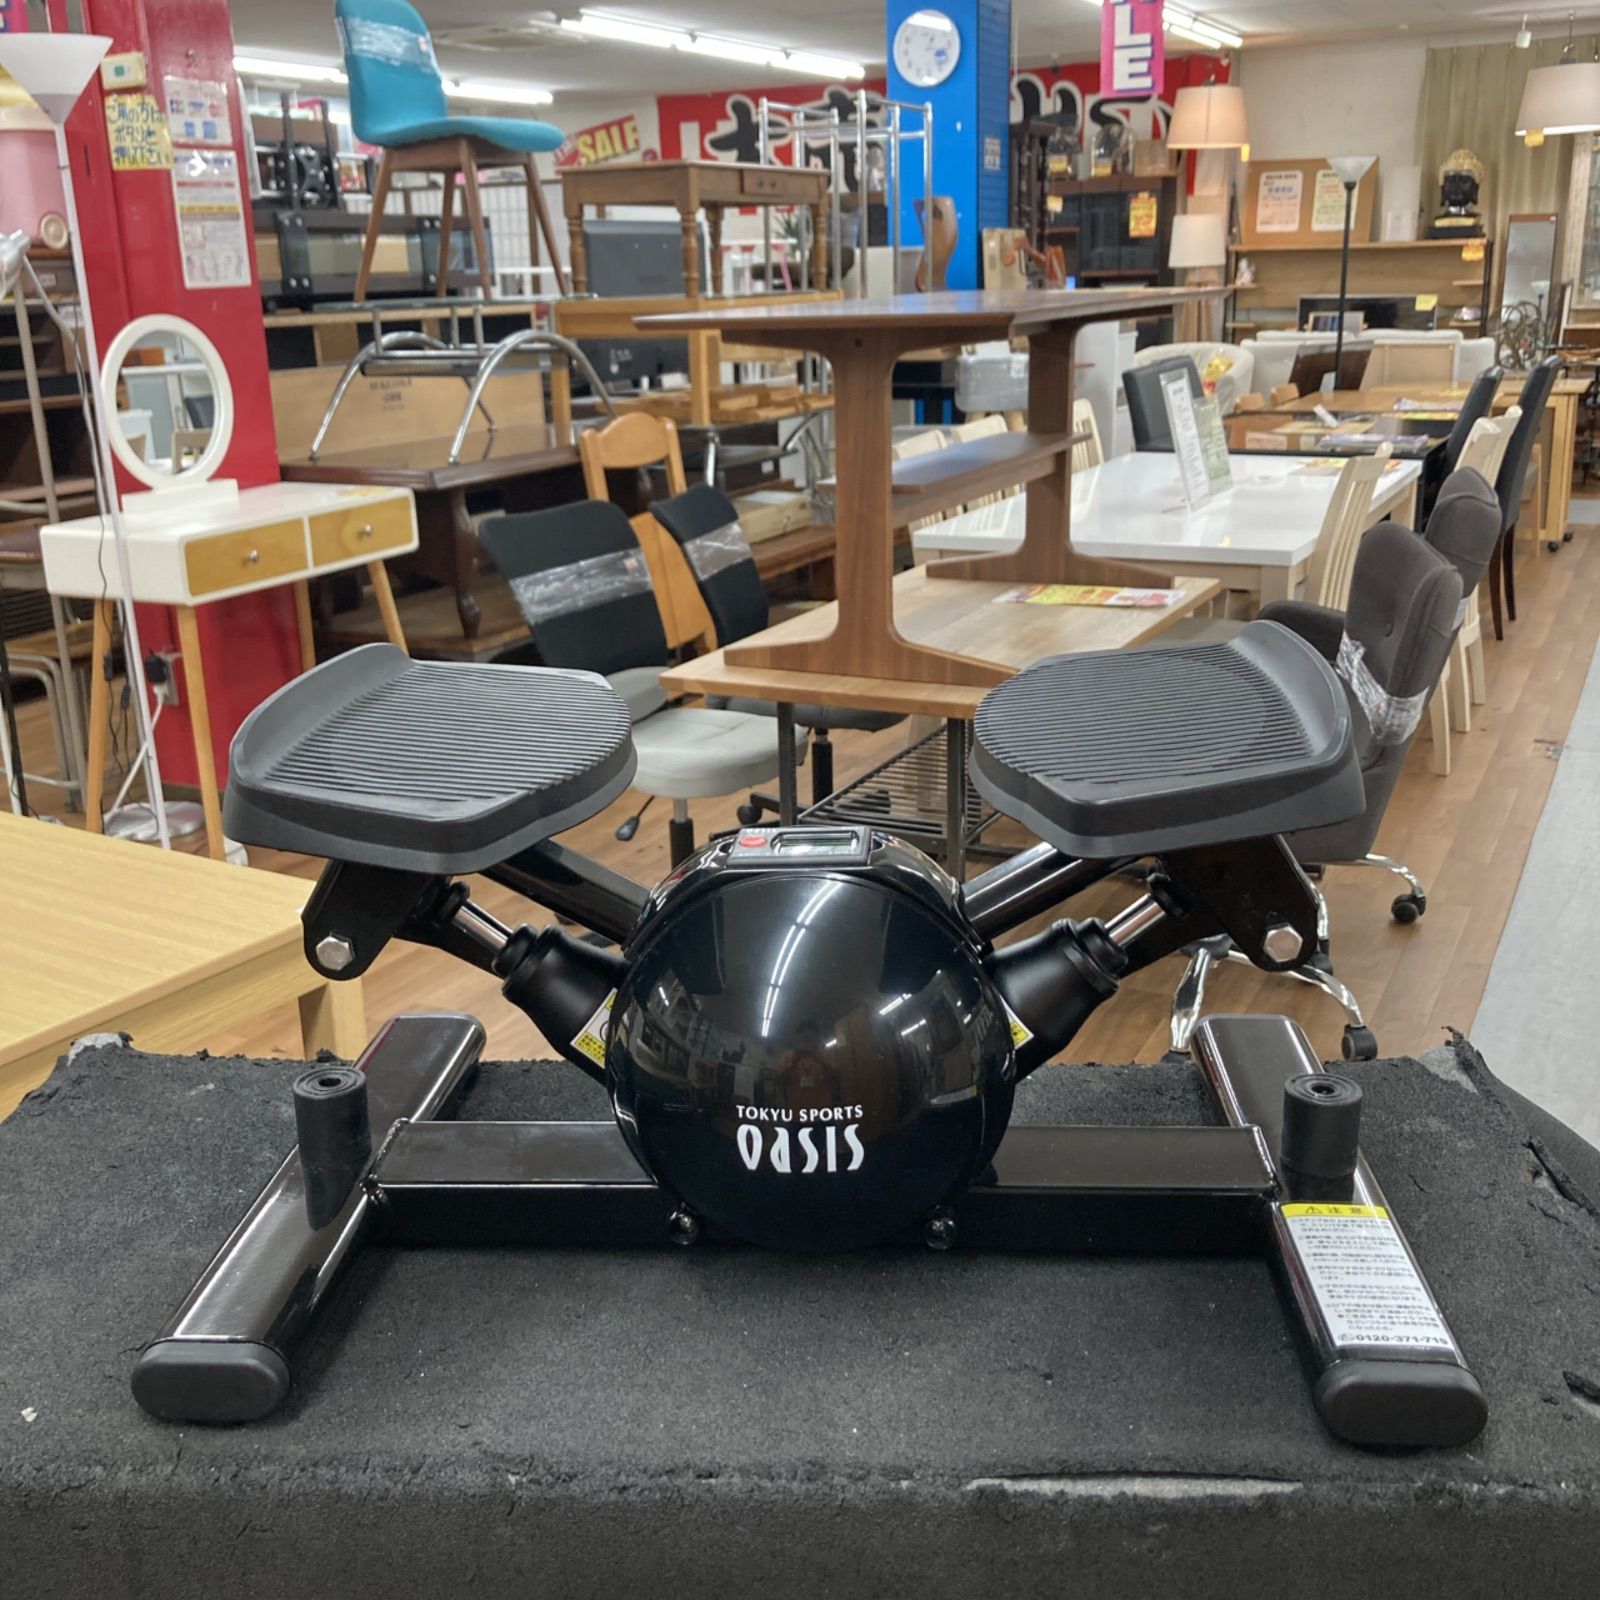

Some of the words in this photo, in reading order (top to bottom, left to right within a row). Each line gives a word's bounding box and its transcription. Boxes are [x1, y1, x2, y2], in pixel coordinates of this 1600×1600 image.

[1110, 0, 1155, 92] LE
[575, 119, 640, 166] SALE
[736, 1105, 793, 1122] TOKYU
[799, 1104, 864, 1122] SPORTS
